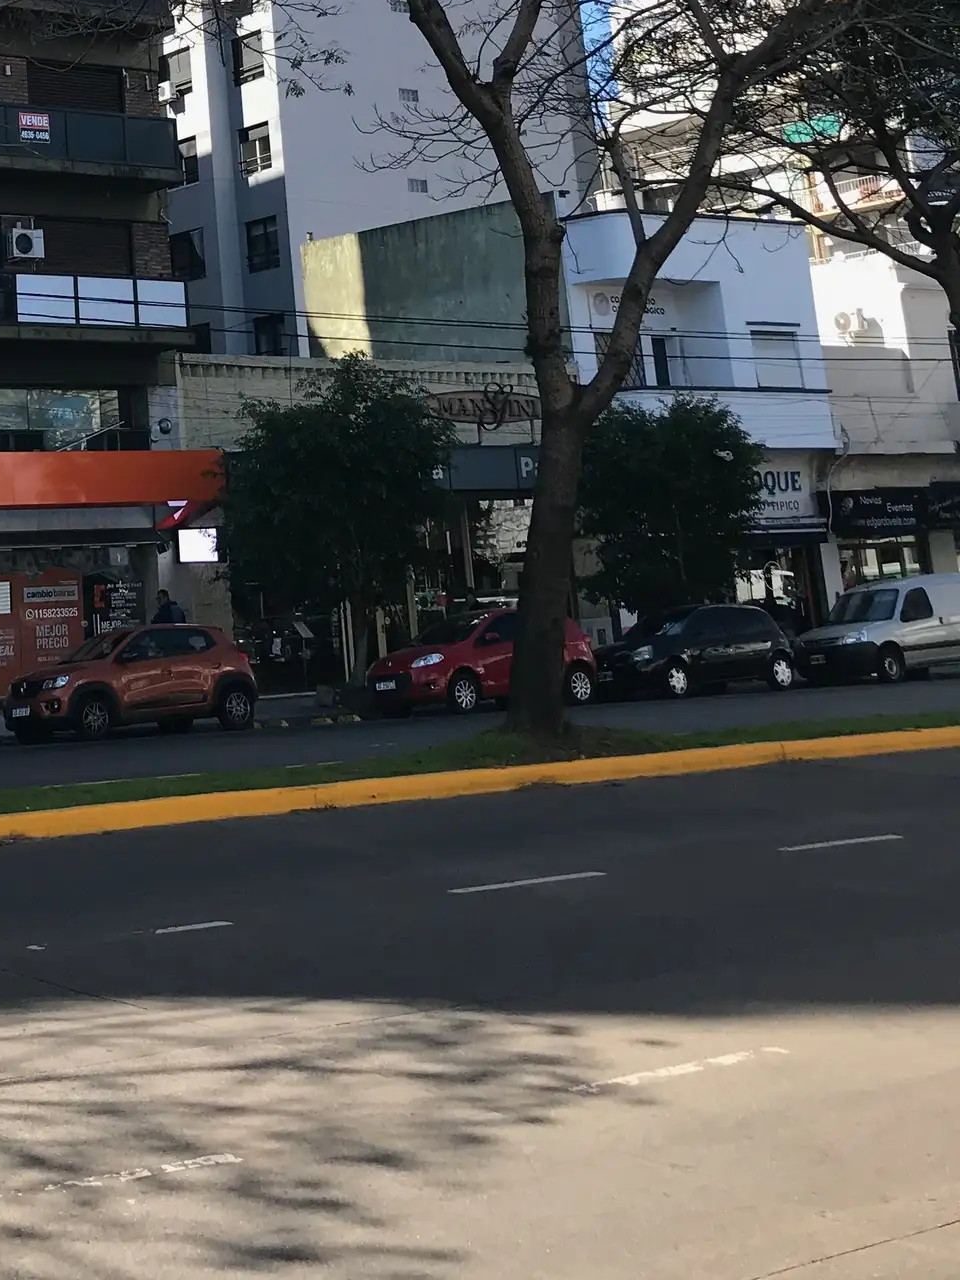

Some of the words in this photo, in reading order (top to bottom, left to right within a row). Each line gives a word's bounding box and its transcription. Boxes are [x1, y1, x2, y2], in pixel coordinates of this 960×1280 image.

[21, 115, 49, 126] VENDE
[886, 502, 914, 512] Eventos
[34, 607, 78, 619] 1158233525
[36, 624, 68, 637] MEJOR
[36, 637, 69, 650] PRECIO
